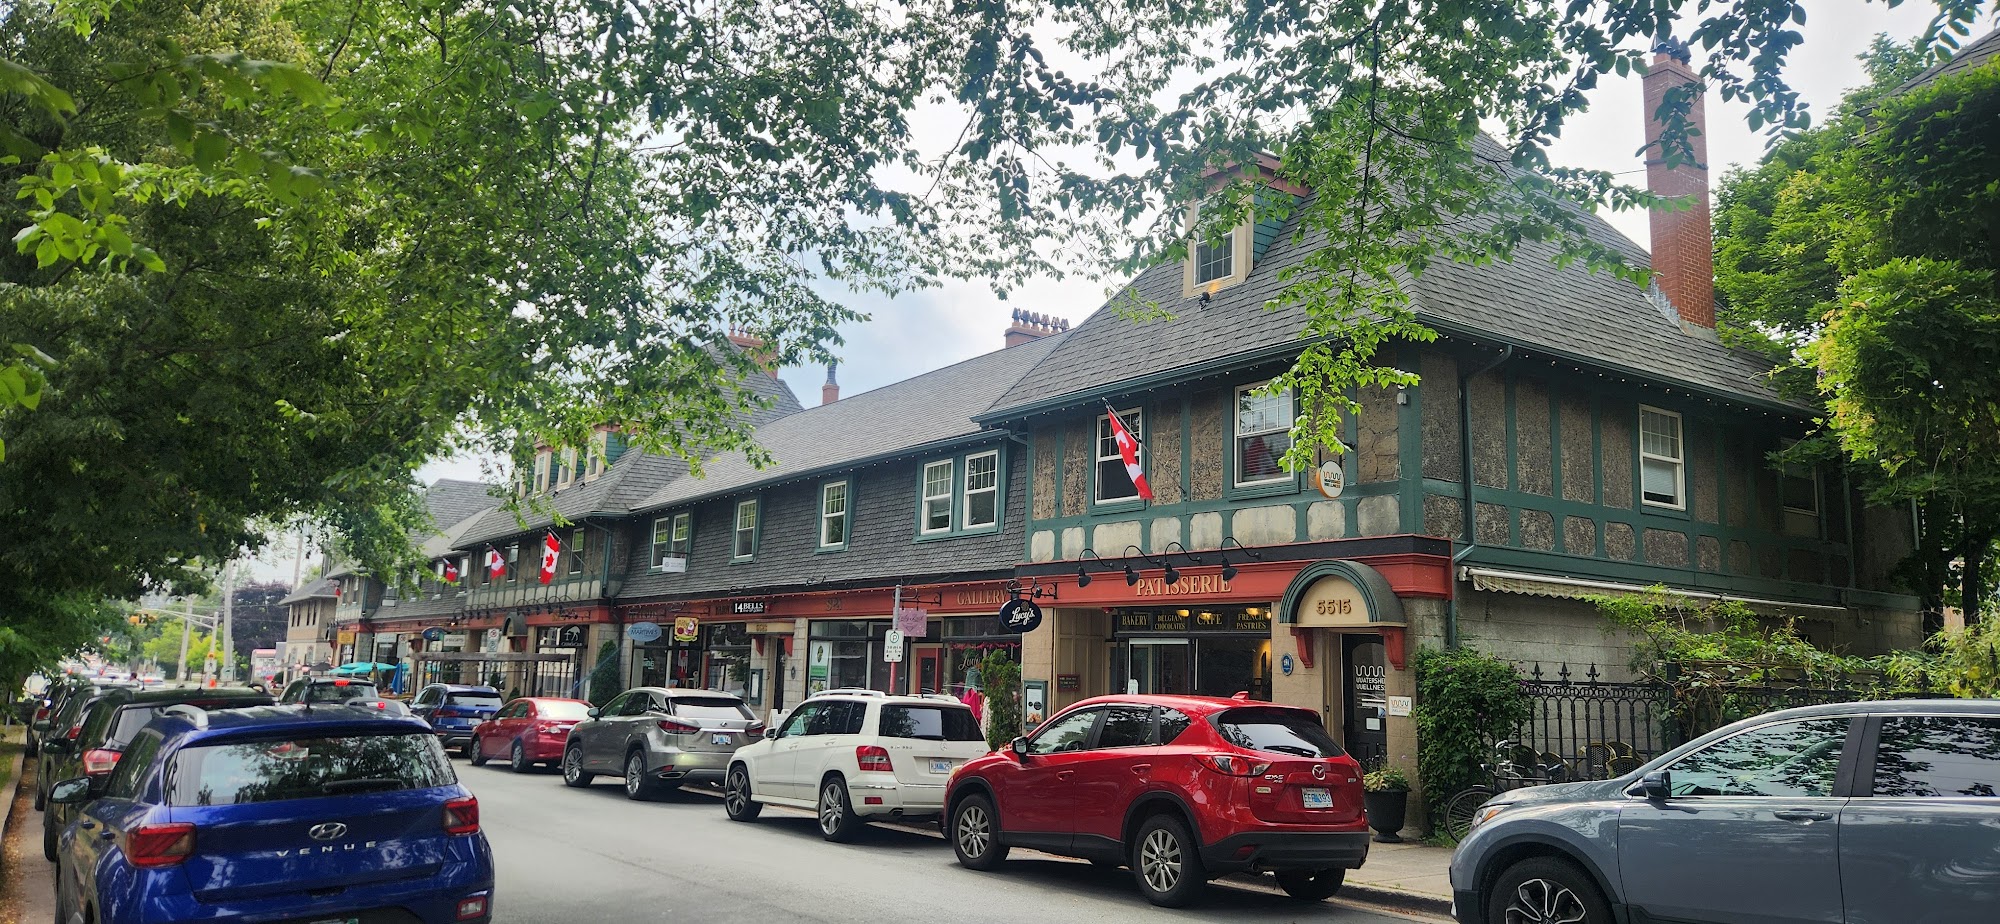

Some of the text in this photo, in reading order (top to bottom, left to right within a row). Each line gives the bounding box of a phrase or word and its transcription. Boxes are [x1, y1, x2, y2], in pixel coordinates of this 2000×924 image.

[1136, 574, 1232, 596] PATISSERIE
[957, 589, 1007, 606] GALLERY
[734, 602, 743, 613] 14
[1316, 598, 1353, 615] 5515
[1008, 606, 1036, 626] Lucy's
[1122, 614, 1148, 626] BAKERY
[1157, 614, 1183, 622] BELGIAN
[1237, 612, 1265, 621] FRENCH
[1154, 622, 1186, 630] CHOCOLATES
[1235, 621, 1267, 630] PASTRIES
[275, 841, 377, 857] VENUE
